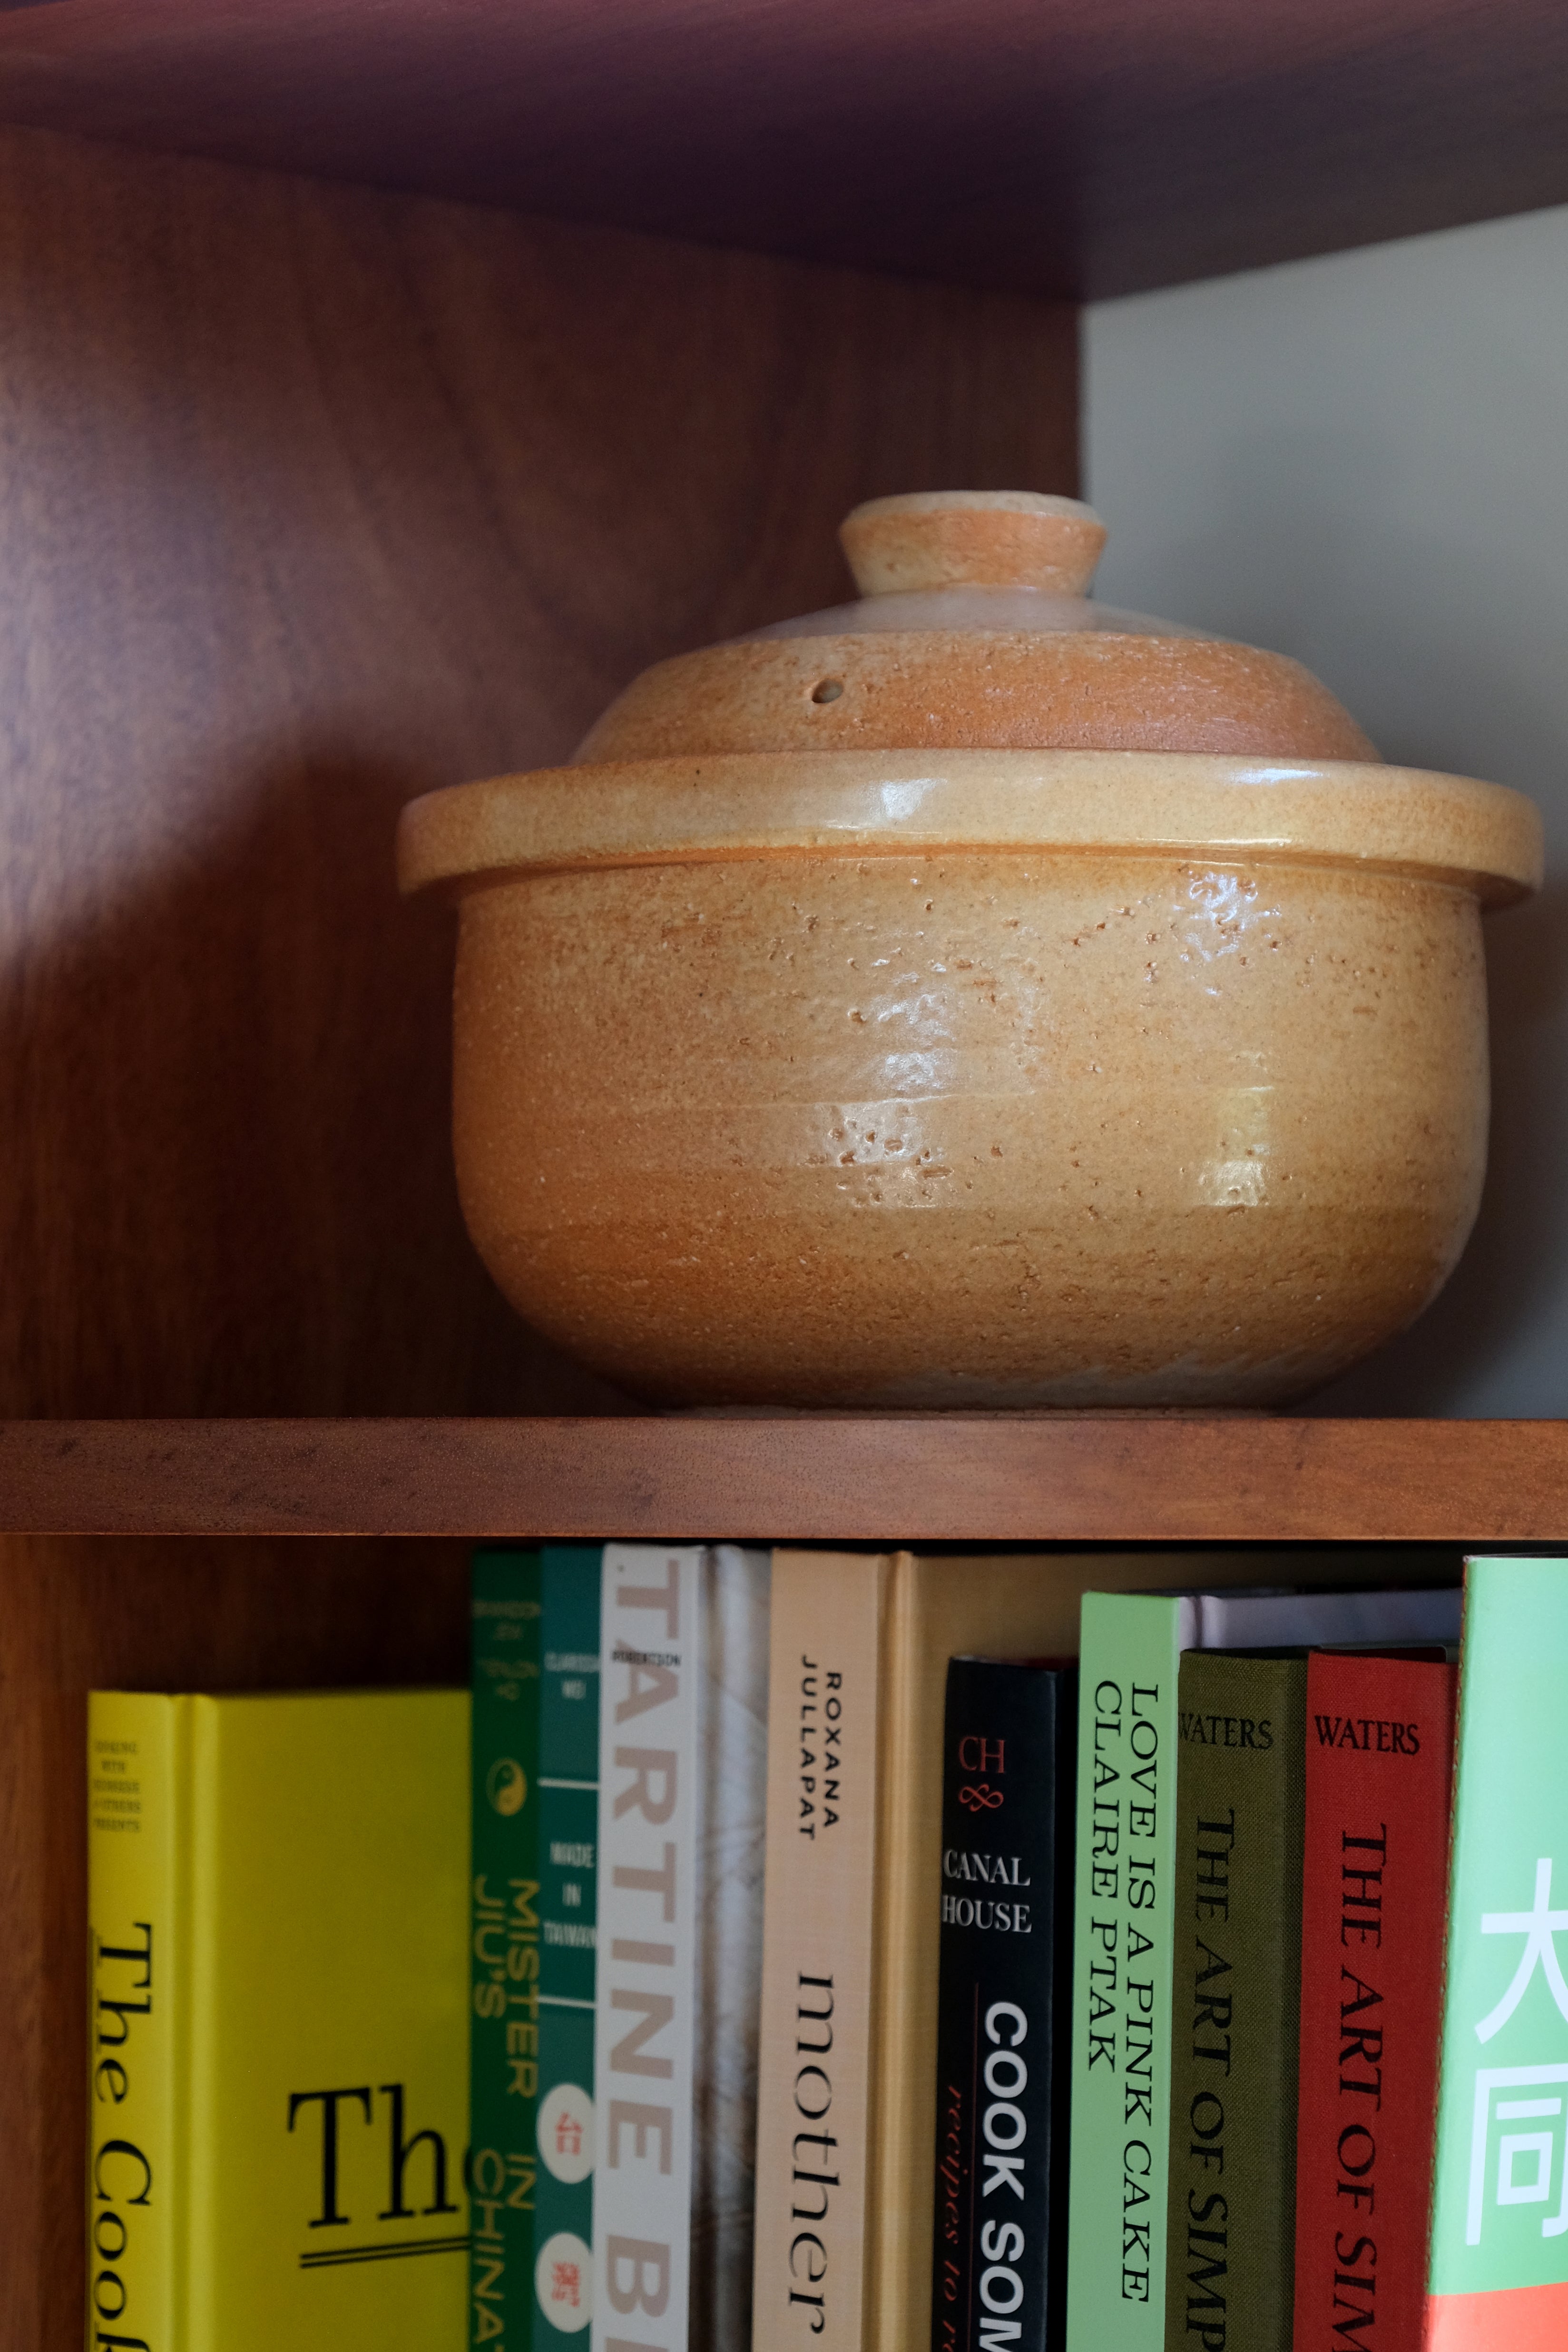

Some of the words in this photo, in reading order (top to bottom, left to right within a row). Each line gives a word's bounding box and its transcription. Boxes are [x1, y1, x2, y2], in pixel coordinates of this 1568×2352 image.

[799, 1654, 818, 1840] JULLAPAT
[824, 1672, 842, 1828] ROXANA
[959, 1735, 1006, 1773] CH
[1092, 1680, 1123, 1899] CLAIRE
[1129, 1682, 1159, 1838] LOVE
[1314, 1715, 1420, 1755] WATERS
[608, 1559, 679, 2175] TARTINE
[941, 1894, 1032, 1934] HOUSE
[942, 1849, 1031, 1887] CANAL
[1127, 1855, 1156, 1909] IS
[1196, 1809, 1235, 1923] THE
[1341, 1822, 1387, 1949] THE
[96, 1922, 152, 2105] The
[474, 1874, 506, 2018] JIU'S
[506, 1879, 540, 2098] MISTER
[1088, 1916, 1118, 2073] PTAK
[1127, 1921, 1155, 1963] A
[1192, 1935, 1233, 2077] ART
[981, 2001, 1028, 2202] COOK
[1125, 1977, 1154, 2126] PINK
[1338, 1963, 1384, 2113] ART
[286, 2083, 471, 2229] Th
[506, 2154, 537, 2210] IN
[788, 1970, 841, 2334] mother
[1190, 2091, 1224, 2175] OF
[1337, 2124, 1376, 2215] OF
[473, 2148, 505, 2352] CHINA
[1122, 2140, 1152, 2303] CAKE
